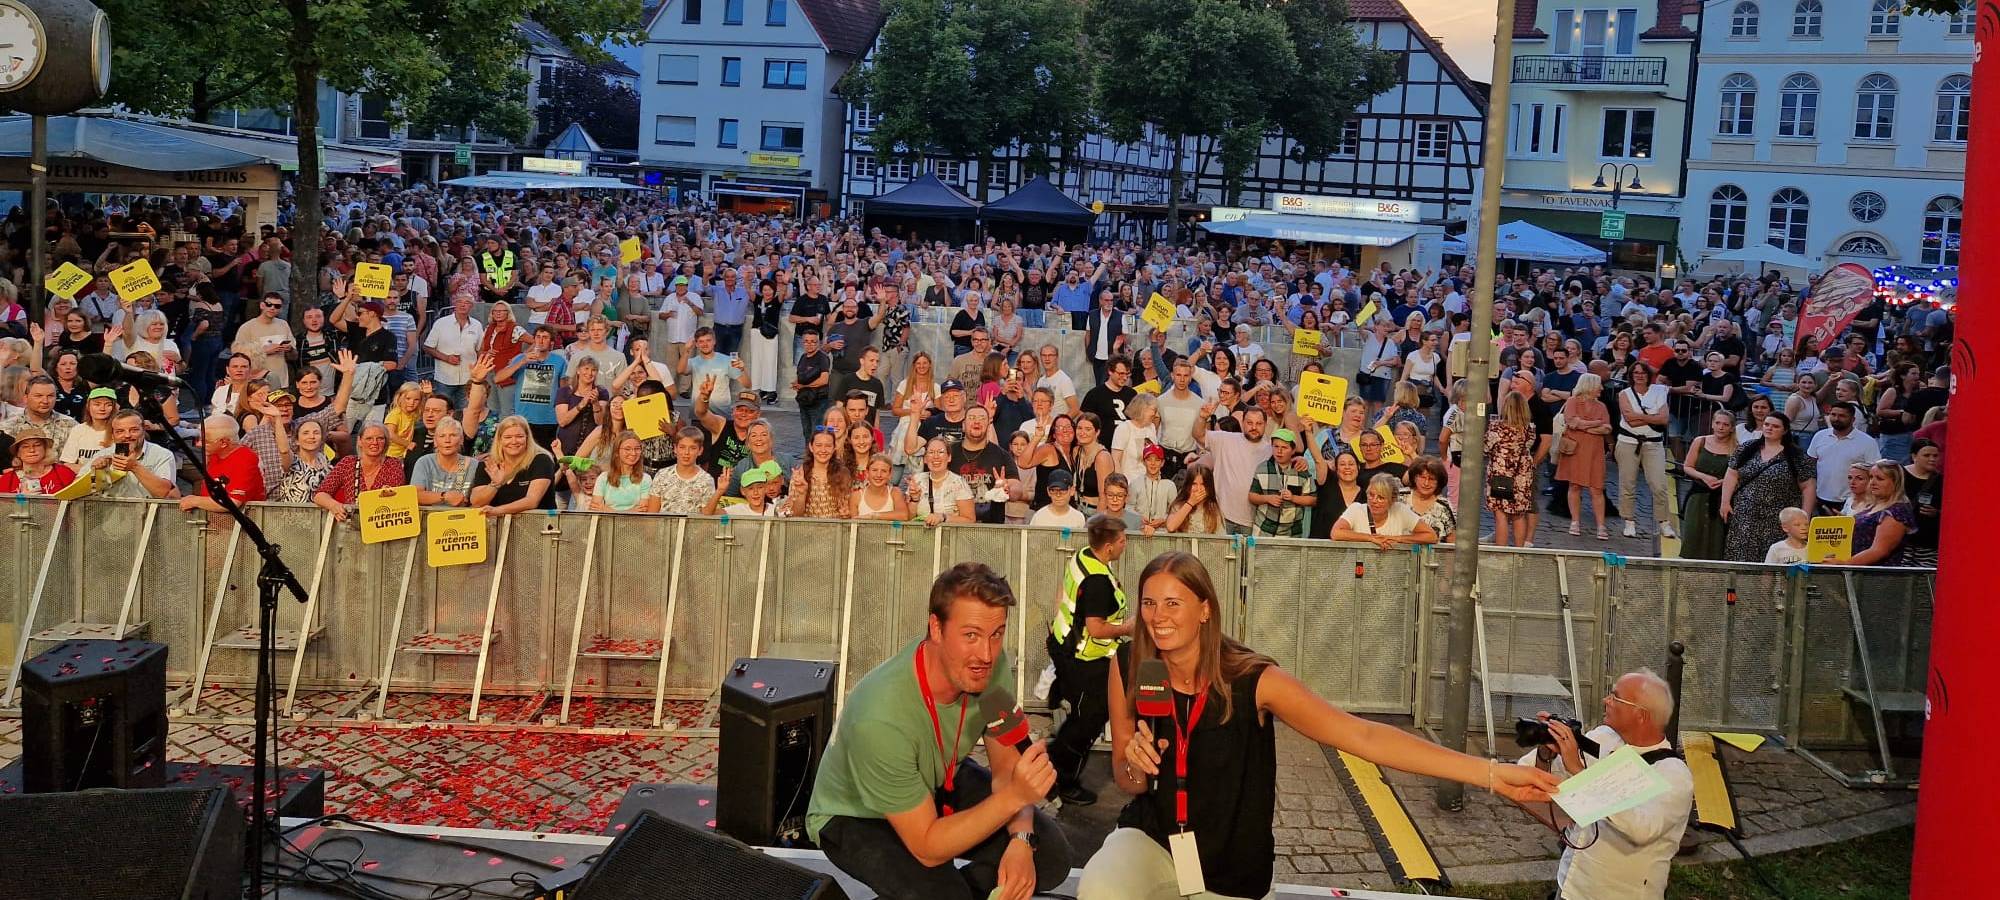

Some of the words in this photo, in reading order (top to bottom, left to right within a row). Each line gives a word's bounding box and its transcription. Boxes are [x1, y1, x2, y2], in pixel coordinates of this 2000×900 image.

[188, 169, 248, 184] VELTINS
[1282, 197, 1303, 207] B&G
[1541, 195, 1555, 205] TO
[1377, 203, 1400, 213] B&G
[128, 279, 153, 293] unna
[1303, 393, 1337, 406] antenne
[1307, 400, 1337, 413] unna
[367, 510, 411, 523] antenne
[375, 516, 413, 529] unna
[1814, 527, 1843, 535] unna
[434, 535, 477, 545] antenne
[442, 541, 479, 553] unna
